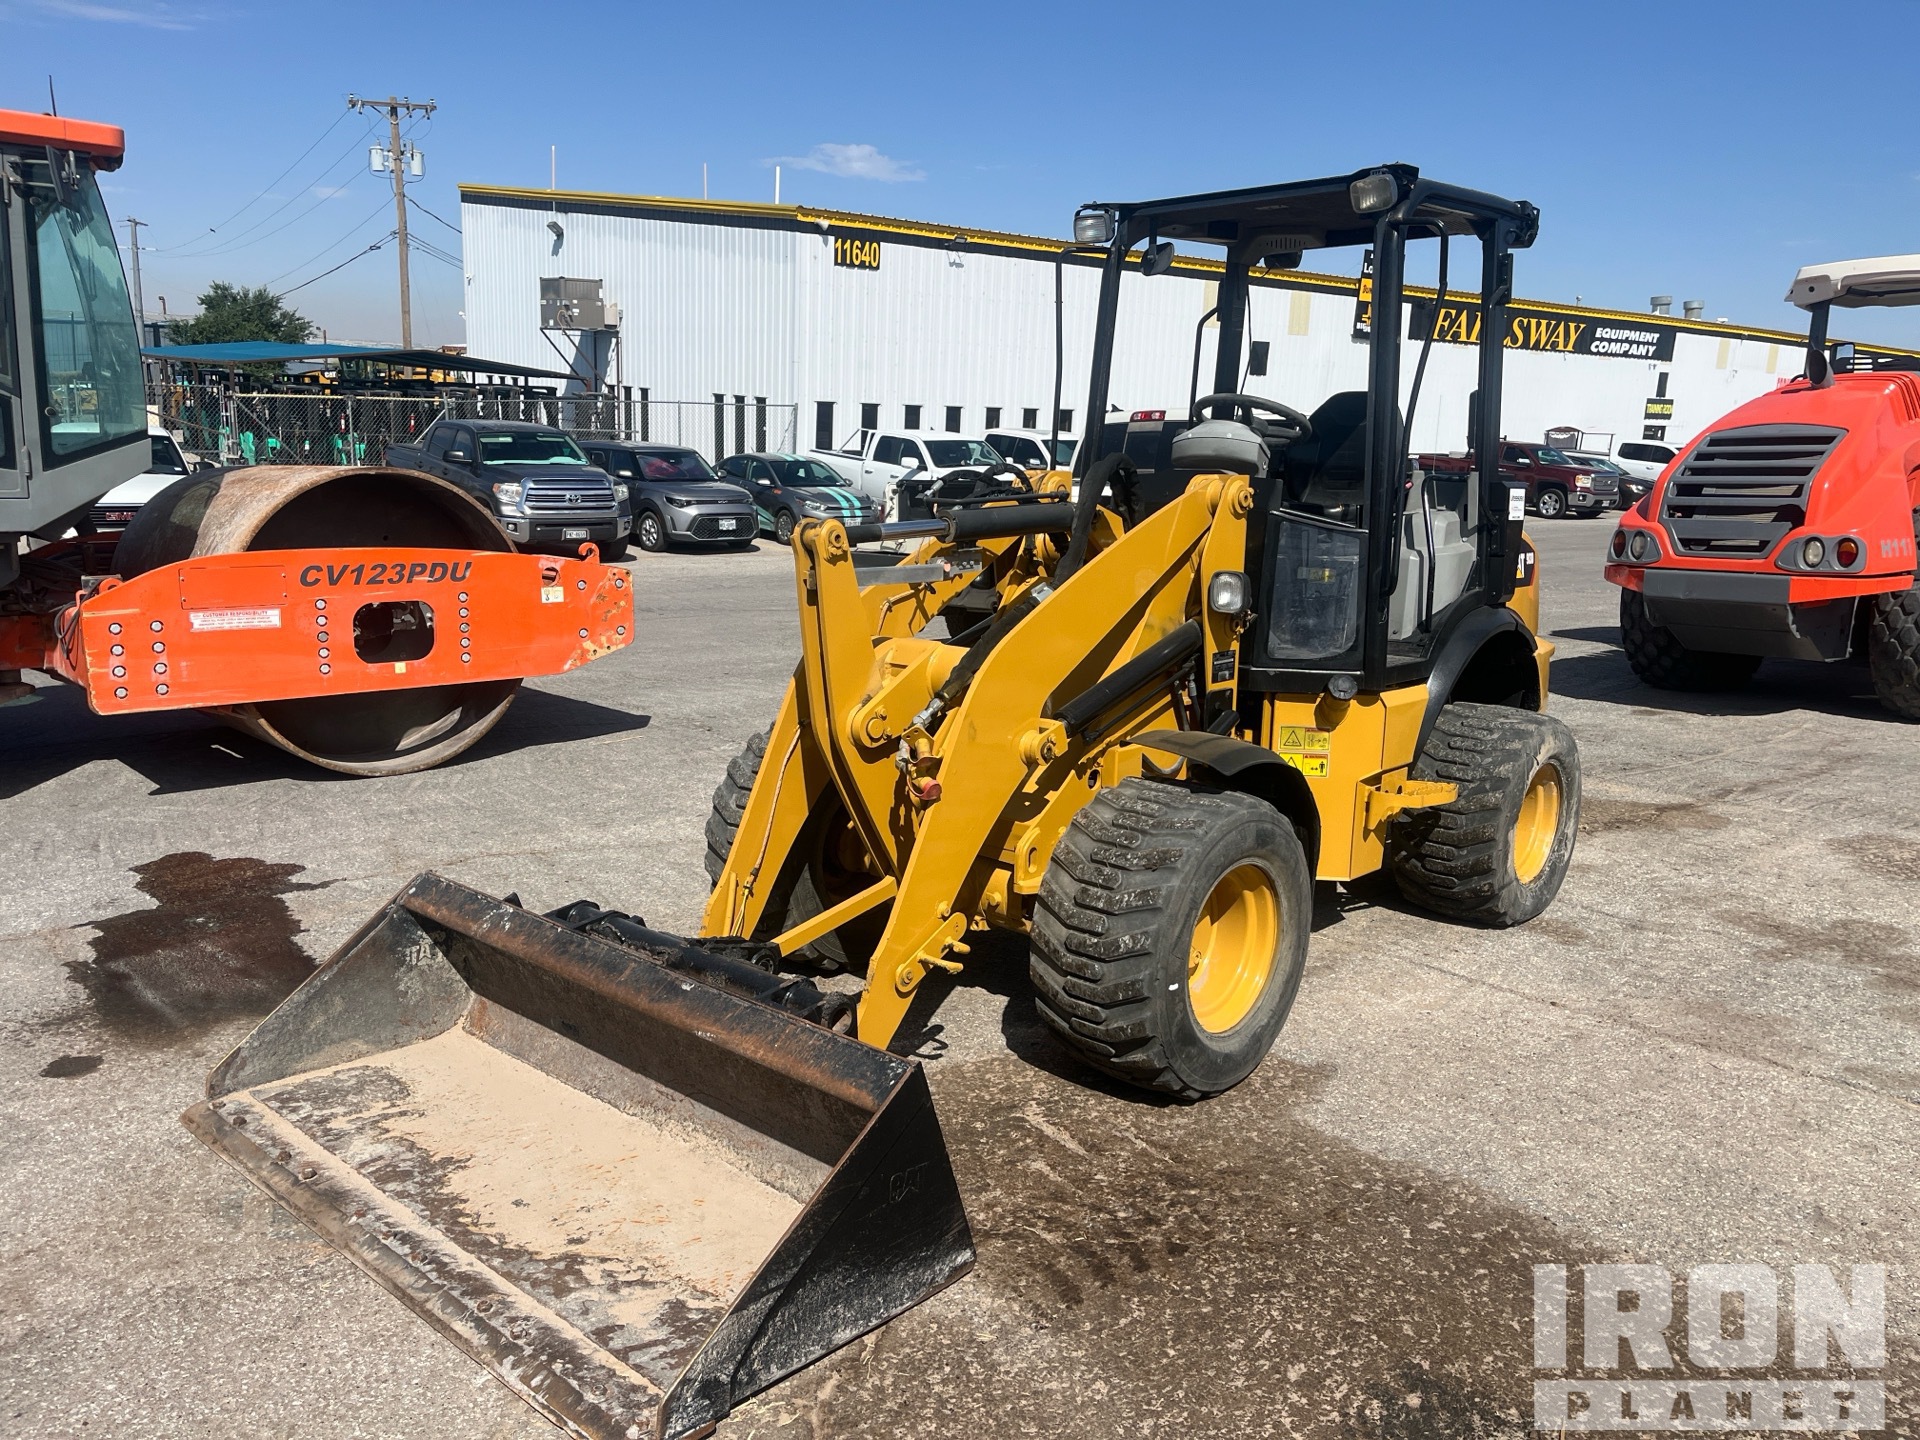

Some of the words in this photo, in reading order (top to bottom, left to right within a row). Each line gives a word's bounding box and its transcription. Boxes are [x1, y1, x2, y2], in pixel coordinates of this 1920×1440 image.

[835, 238, 880, 268] 11640
[1432, 307, 1586, 352] FALSWAY
[1595, 327, 1660, 343] EQUIPMENT
[1590, 340, 1657, 357] COMPANY
[299, 561, 473, 587] CV123PDU
[1515, 552, 1526, 579] AT
[202, 611, 229, 619] CUSTOMER
